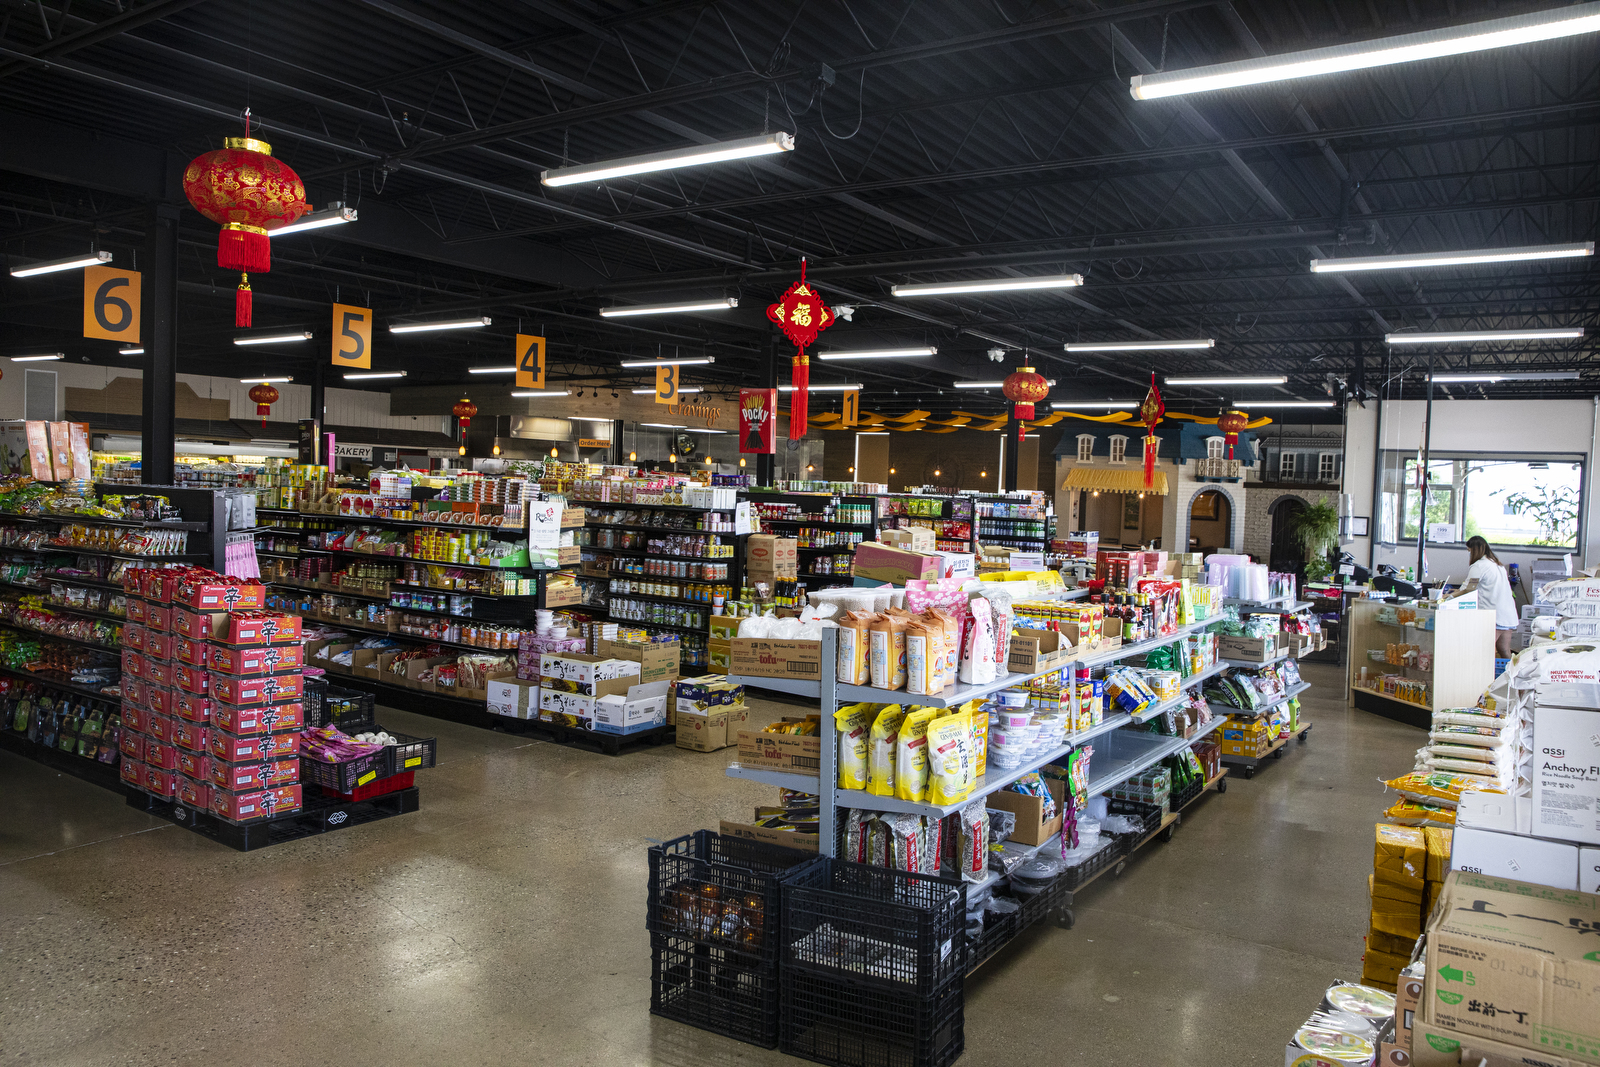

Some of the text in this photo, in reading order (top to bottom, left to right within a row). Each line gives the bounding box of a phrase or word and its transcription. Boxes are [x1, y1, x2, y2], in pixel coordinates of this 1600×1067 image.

[94, 278, 132, 332] 6
[790, 302, 812, 326] 福
[339, 312, 365, 360] 5
[520, 343, 541, 382] 4
[659, 364, 674, 398] 3
[847, 394, 854, 421] 1
[335, 446, 370, 456] BAKERY
[224, 587, 242, 611] 辛
[261, 619, 279, 645] 辛
[264, 648, 281, 674] 辛
[759, 654, 777, 664] tofu
[263, 679, 280, 704] 辛
[262, 708, 280, 734] 辛
[258, 736, 276, 761] 辛
[765, 749, 782, 759] tofu
[1542, 747, 1565, 755] assi
[257, 763, 276, 789] 辛
[1543, 762, 1586, 776] Anchovy
[261, 791, 279, 817] 辛
[1461, 865, 1482, 874] assi
[1466, 971, 1475, 986] UP
[1553, 975, 1581, 989] 2021
[1439, 991, 1460, 1001] NISSIN
[1468, 1000, 1528, 1024] 出前一丁
[1457, 1017, 1479, 1027] NOODLE
[1512, 1031, 1529, 1039] BASE
[1429, 1037, 1456, 1048] NISSIN
